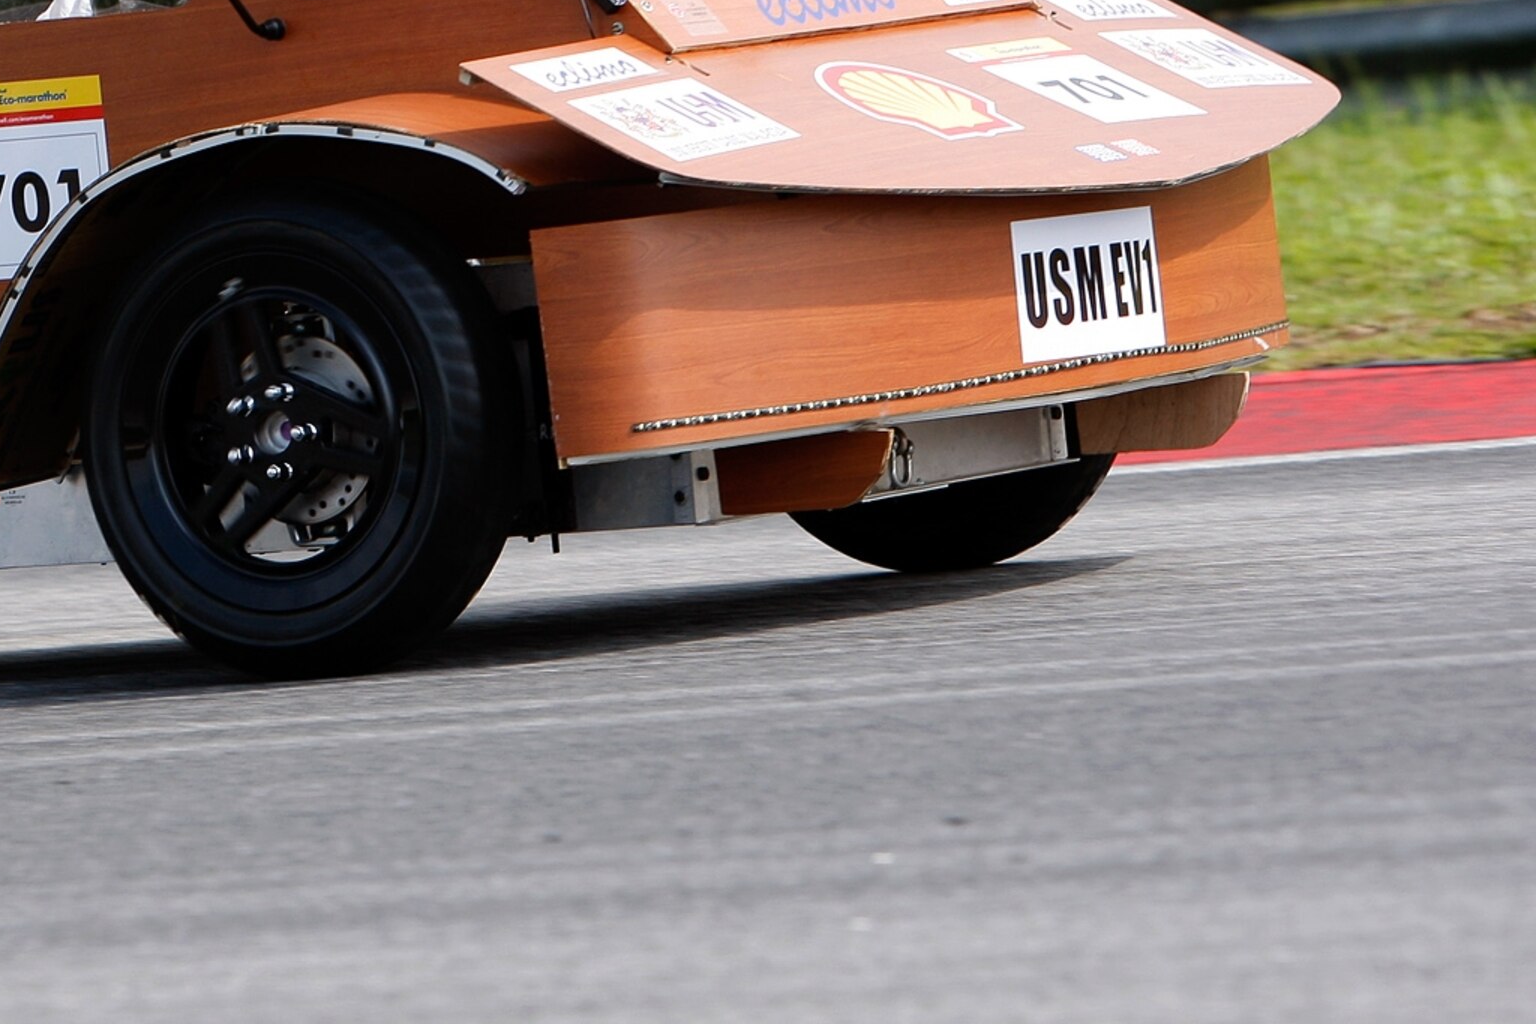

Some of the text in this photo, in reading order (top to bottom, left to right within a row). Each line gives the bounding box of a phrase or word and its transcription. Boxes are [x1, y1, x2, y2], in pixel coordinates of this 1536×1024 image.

[1037, 75, 1149, 104] 701
[1020, 238, 1157, 329] USM EV1
